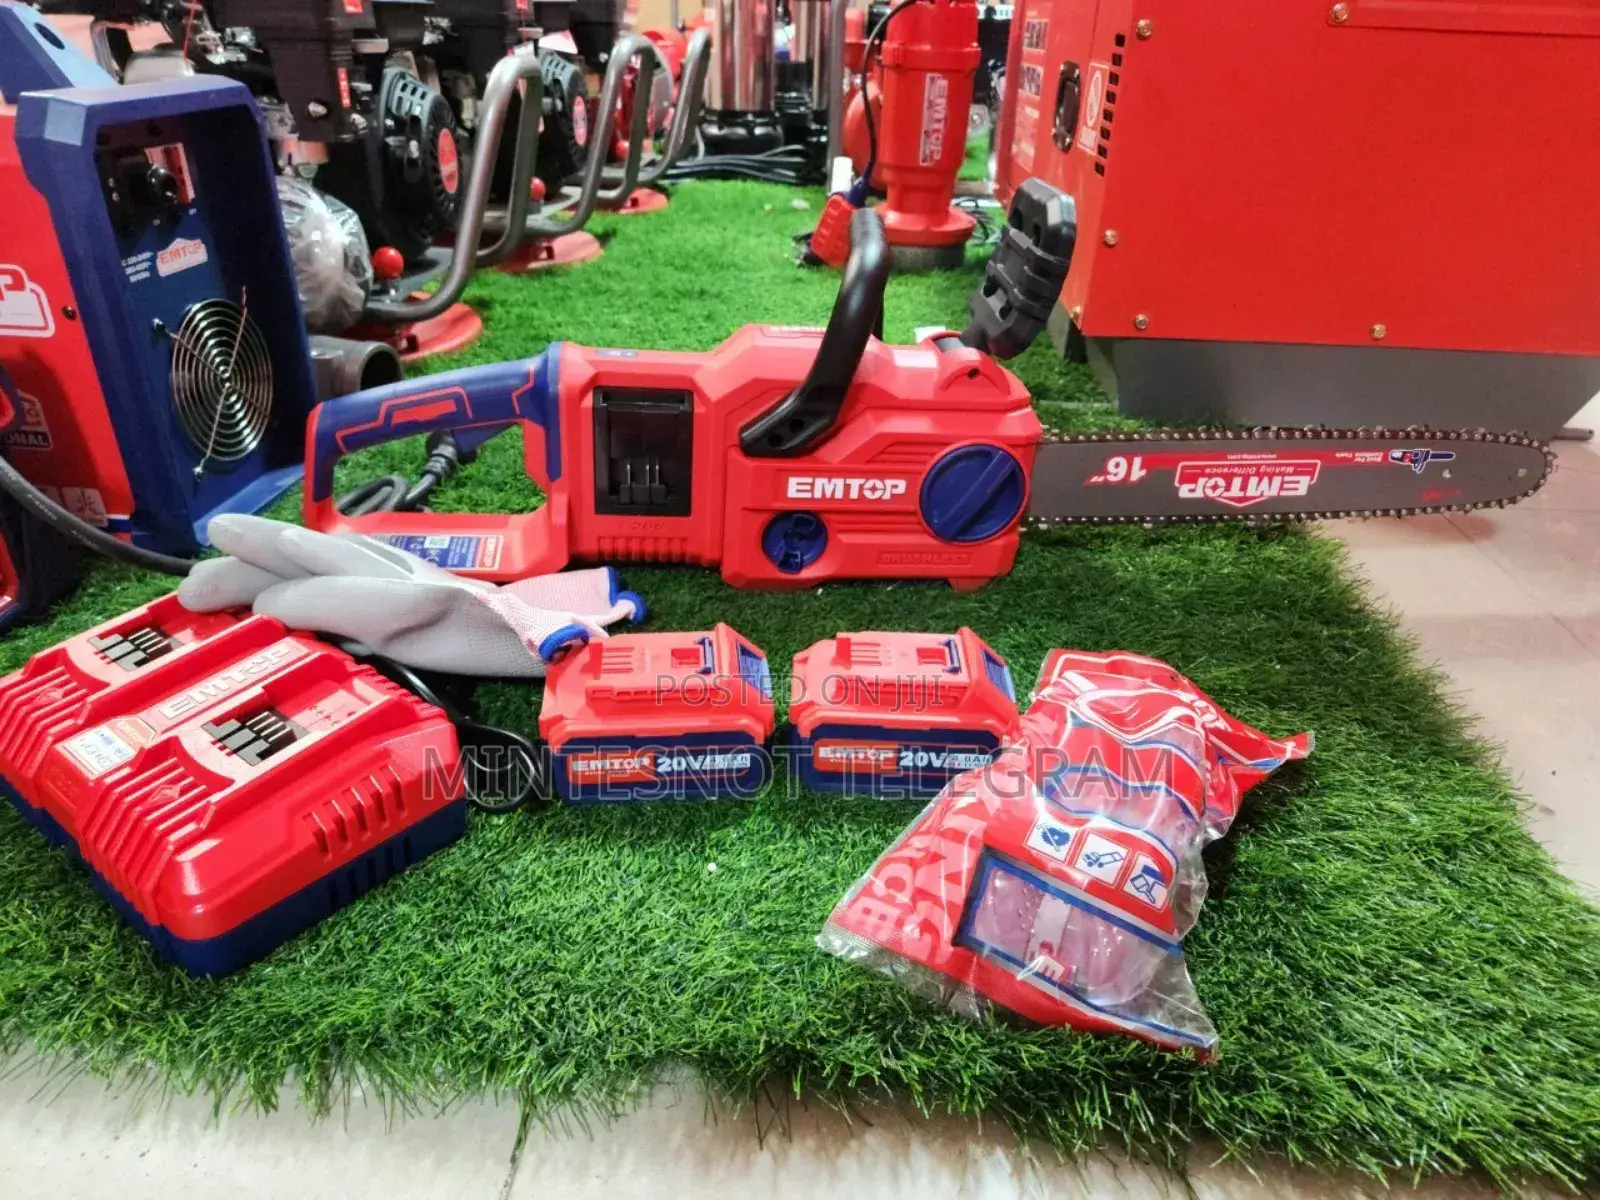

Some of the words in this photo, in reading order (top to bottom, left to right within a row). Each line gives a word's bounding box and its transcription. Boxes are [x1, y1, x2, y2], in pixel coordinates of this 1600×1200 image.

[160, 242, 201, 264] EMTOP
[1204, 465, 1256, 475] Difference
[1260, 465, 1295, 474] Making
[786, 476, 907, 500] EMTOP
[1178, 475, 1311, 499] EMTOP
[882, 553, 971, 565] BRUSHLESS
[159, 642, 292, 720] EMTOP
[572, 756, 651, 772] EMTOP
[656, 755, 706, 772] 20V
[818, 746, 895, 760] EMTOP
[899, 751, 947, 768] 20V
